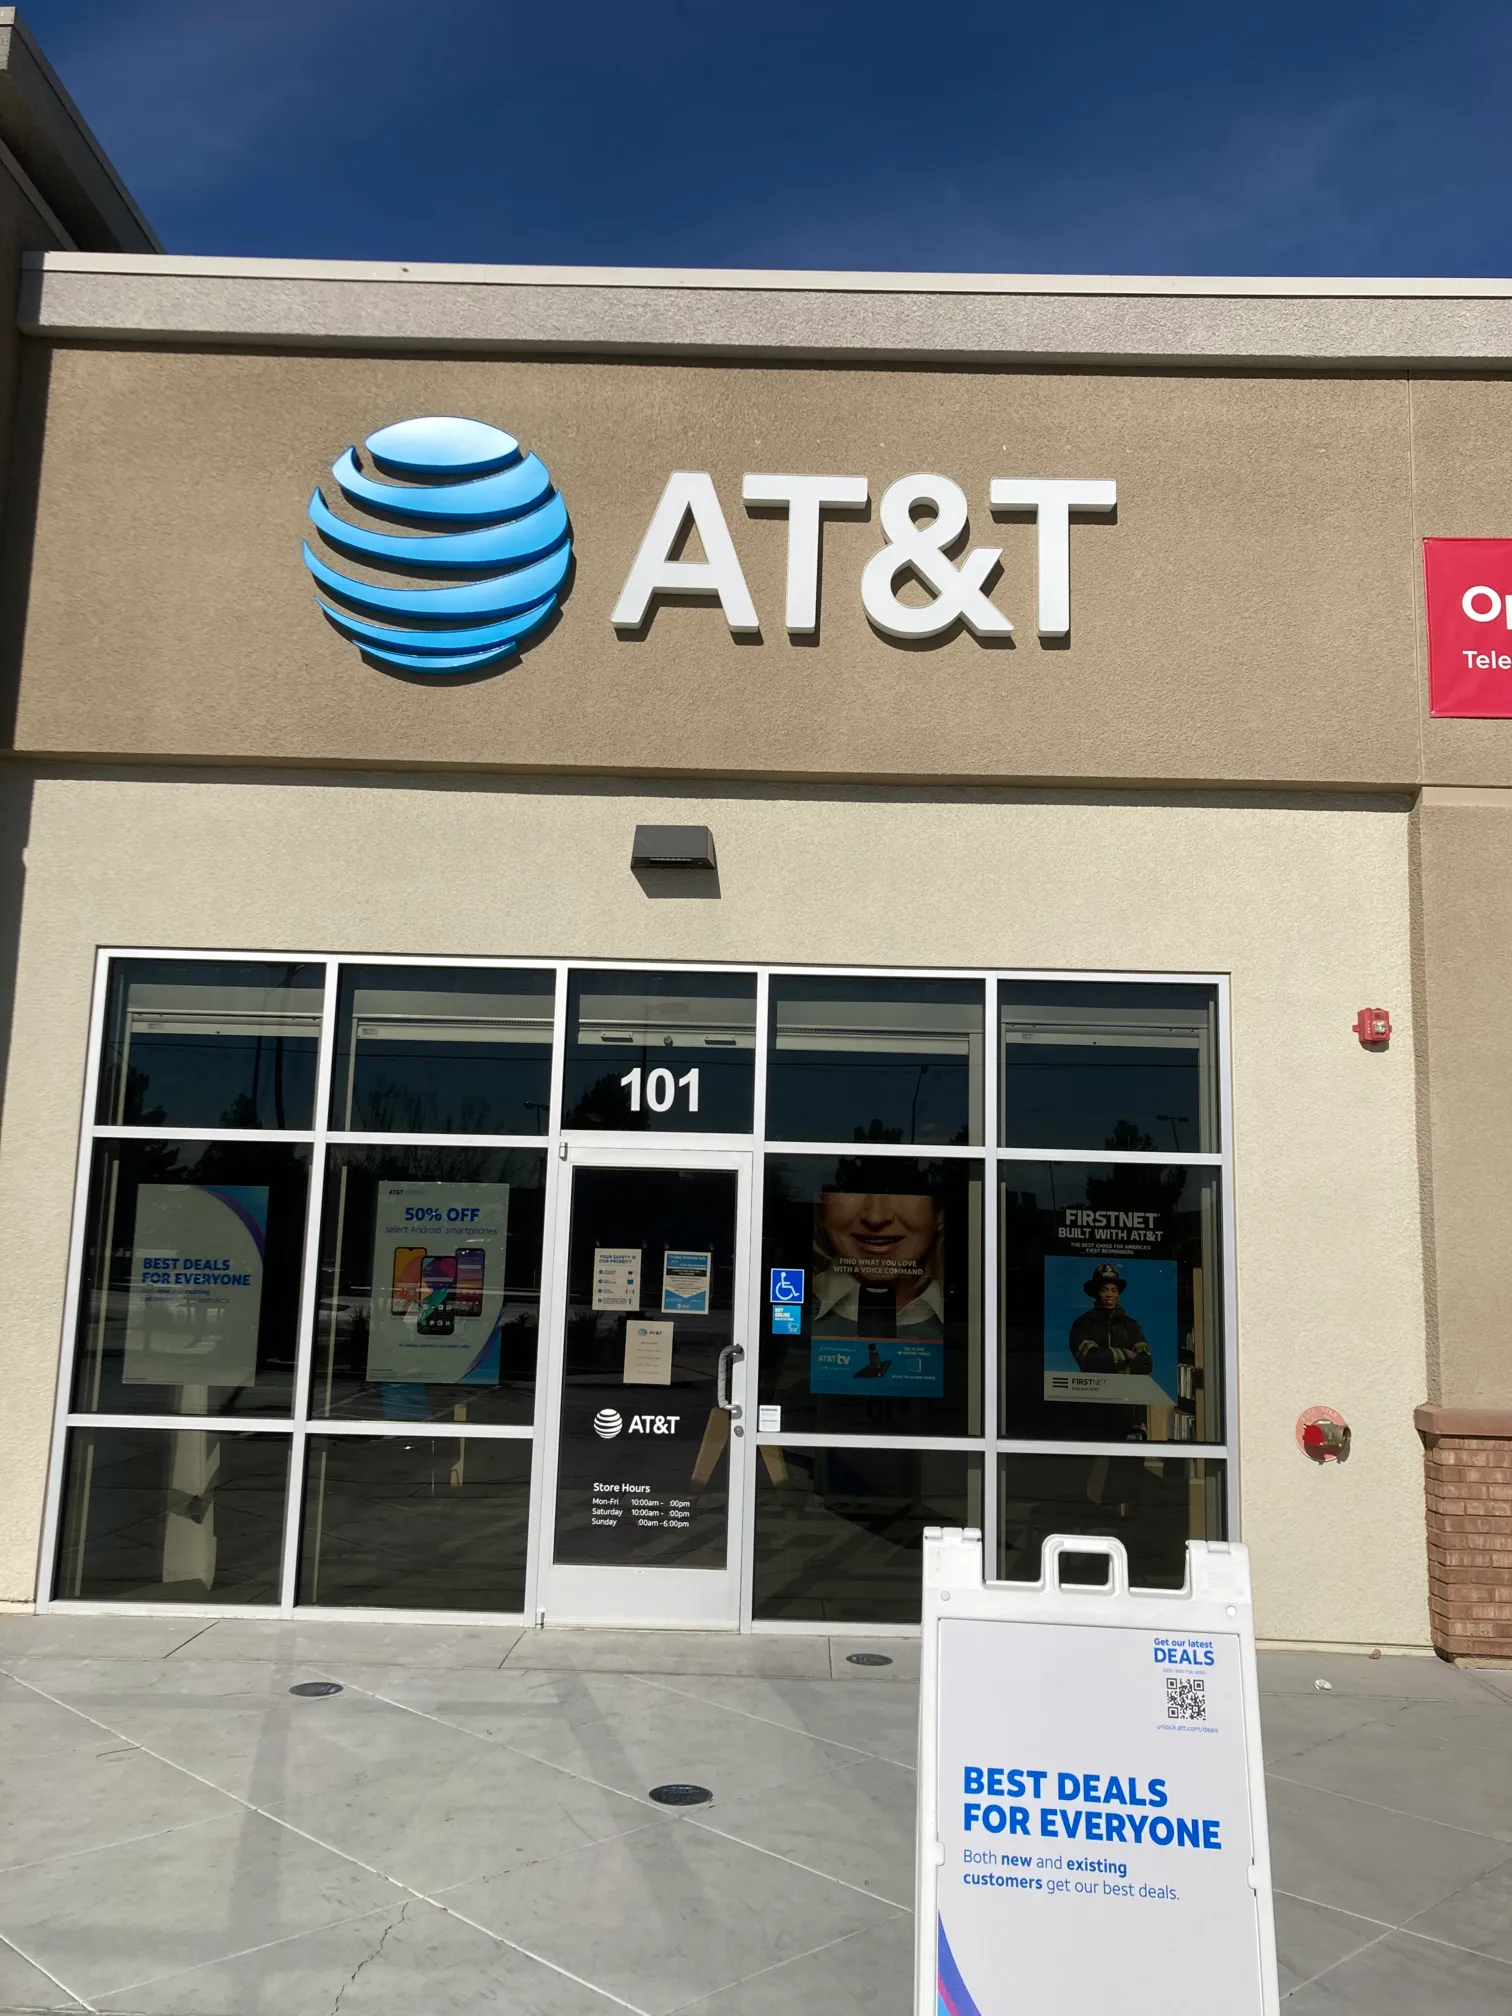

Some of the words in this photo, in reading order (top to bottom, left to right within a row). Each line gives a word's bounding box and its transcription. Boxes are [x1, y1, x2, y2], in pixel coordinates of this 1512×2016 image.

[611, 469, 1118, 640] AT&T
[1461, 585, 1512, 630] O
[620, 1067, 700, 1112] 101
[404, 1207, 442, 1221] 50%
[446, 1208, 480, 1222] OFF
[1065, 1209, 1159, 1229] FIRSTNET
[444, 1227, 498, 1236] smartphones
[1058, 1227, 1092, 1239] BUILT
[1094, 1228, 1127, 1240] WITH
[1130, 1230, 1164, 1242] AT&T
[143, 1257, 180, 1270] BEST
[183, 1258, 231, 1271] DEALS
[141, 1272, 170, 1284] FOR
[174, 1273, 251, 1286] EVERYONE
[817, 1355, 836, 1363] AT&T
[836, 1353, 851, 1365] tv
[628, 1415, 681, 1434] AT&T
[593, 1482, 620, 1492] Store
[621, 1483, 651, 1493] Hours
[592, 1498, 619, 1506] Mon-Fri
[631, 1498, 660, 1507] 10:00am
[592, 1508, 623, 1517] Saturday
[631, 1508, 660, 1516] 10:00am
[591, 1518, 617, 1527] Sunday
[1154, 1638, 1169, 1646] Get
[1171, 1639, 1186, 1647] our
[1188, 1639, 1213, 1649] latest
[1153, 1647, 1215, 1666] DEALS
[963, 1765, 1048, 1800] BEST
[1057, 1772, 1168, 1808] DEALS
[963, 1802, 1031, 1836] FOR
[1040, 1808, 1222, 1850] EVERYONE
[963, 1849, 998, 1865] Both
[1001, 1854, 1033, 1868] new
[1036, 1855, 1063, 1870] and
[1066, 1857, 1128, 1878] existing
[963, 1872, 1043, 1890] customers
[1046, 1878, 1071, 1894] get
[1074, 1882, 1100, 1894] our
[1103, 1880, 1135, 1897] best
[1138, 1883, 1180, 1900] deals.
